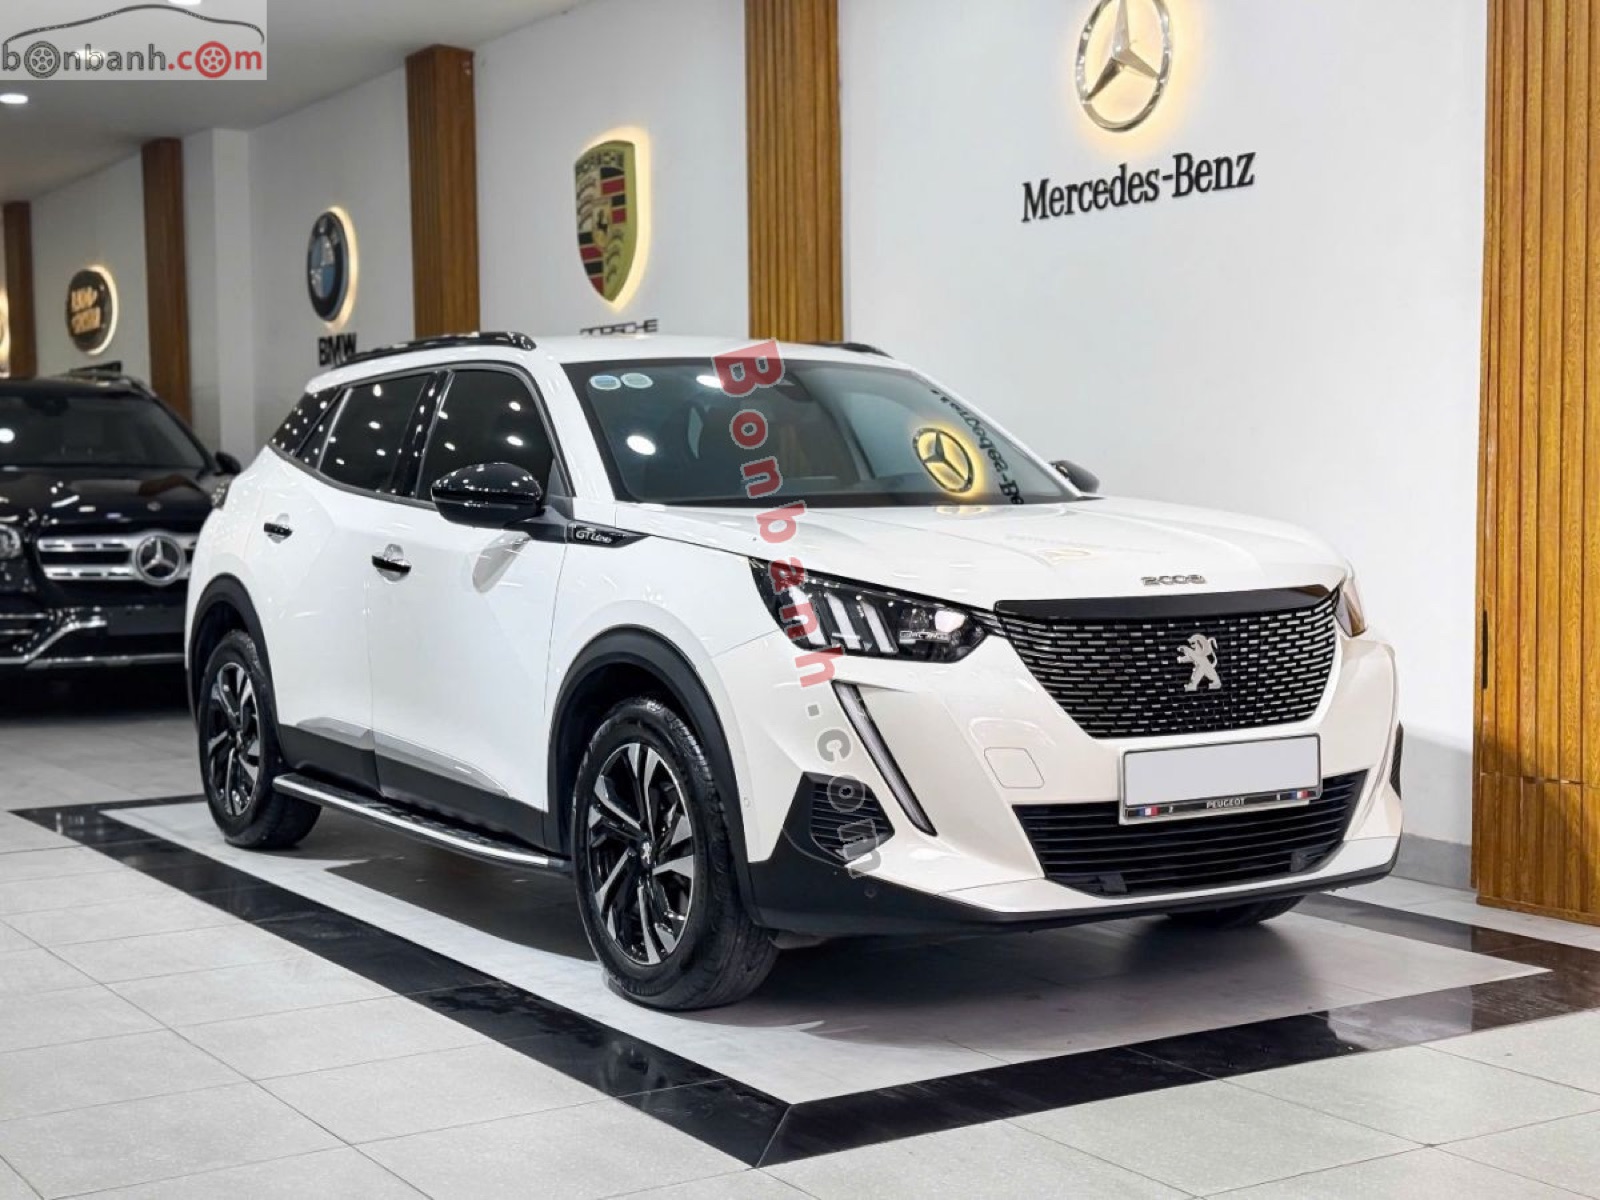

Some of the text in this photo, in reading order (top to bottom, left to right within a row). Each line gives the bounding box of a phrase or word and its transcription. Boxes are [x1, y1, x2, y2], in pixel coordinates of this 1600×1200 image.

[1021, 152, 1256, 223] Mercedes-Benz
[318, 332, 357, 367] BMW
[1141, 574, 1206, 586] 2008
[1206, 797, 1245, 809] PEUGEOT
